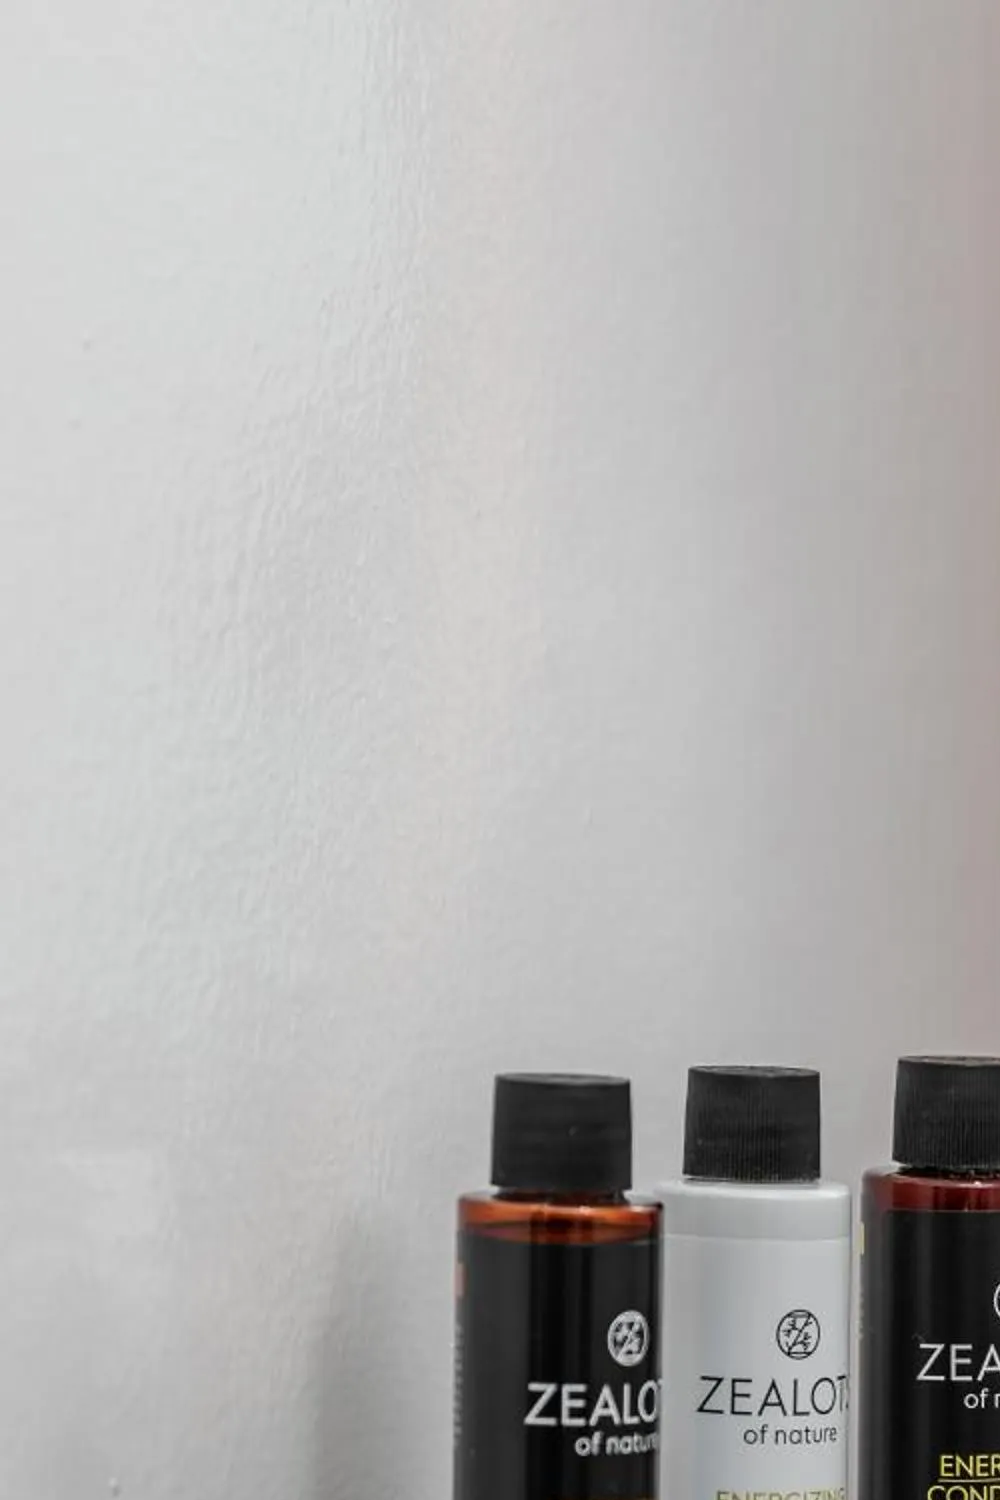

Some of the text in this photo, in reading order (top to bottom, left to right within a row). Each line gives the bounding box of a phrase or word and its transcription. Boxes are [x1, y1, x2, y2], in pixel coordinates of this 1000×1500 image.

[523, 1379, 664, 1427] ZEALO
[963, 1387, 989, 1409] of
[574, 1431, 660, 1457] of natur
[743, 1424, 837, 1445] of nature
